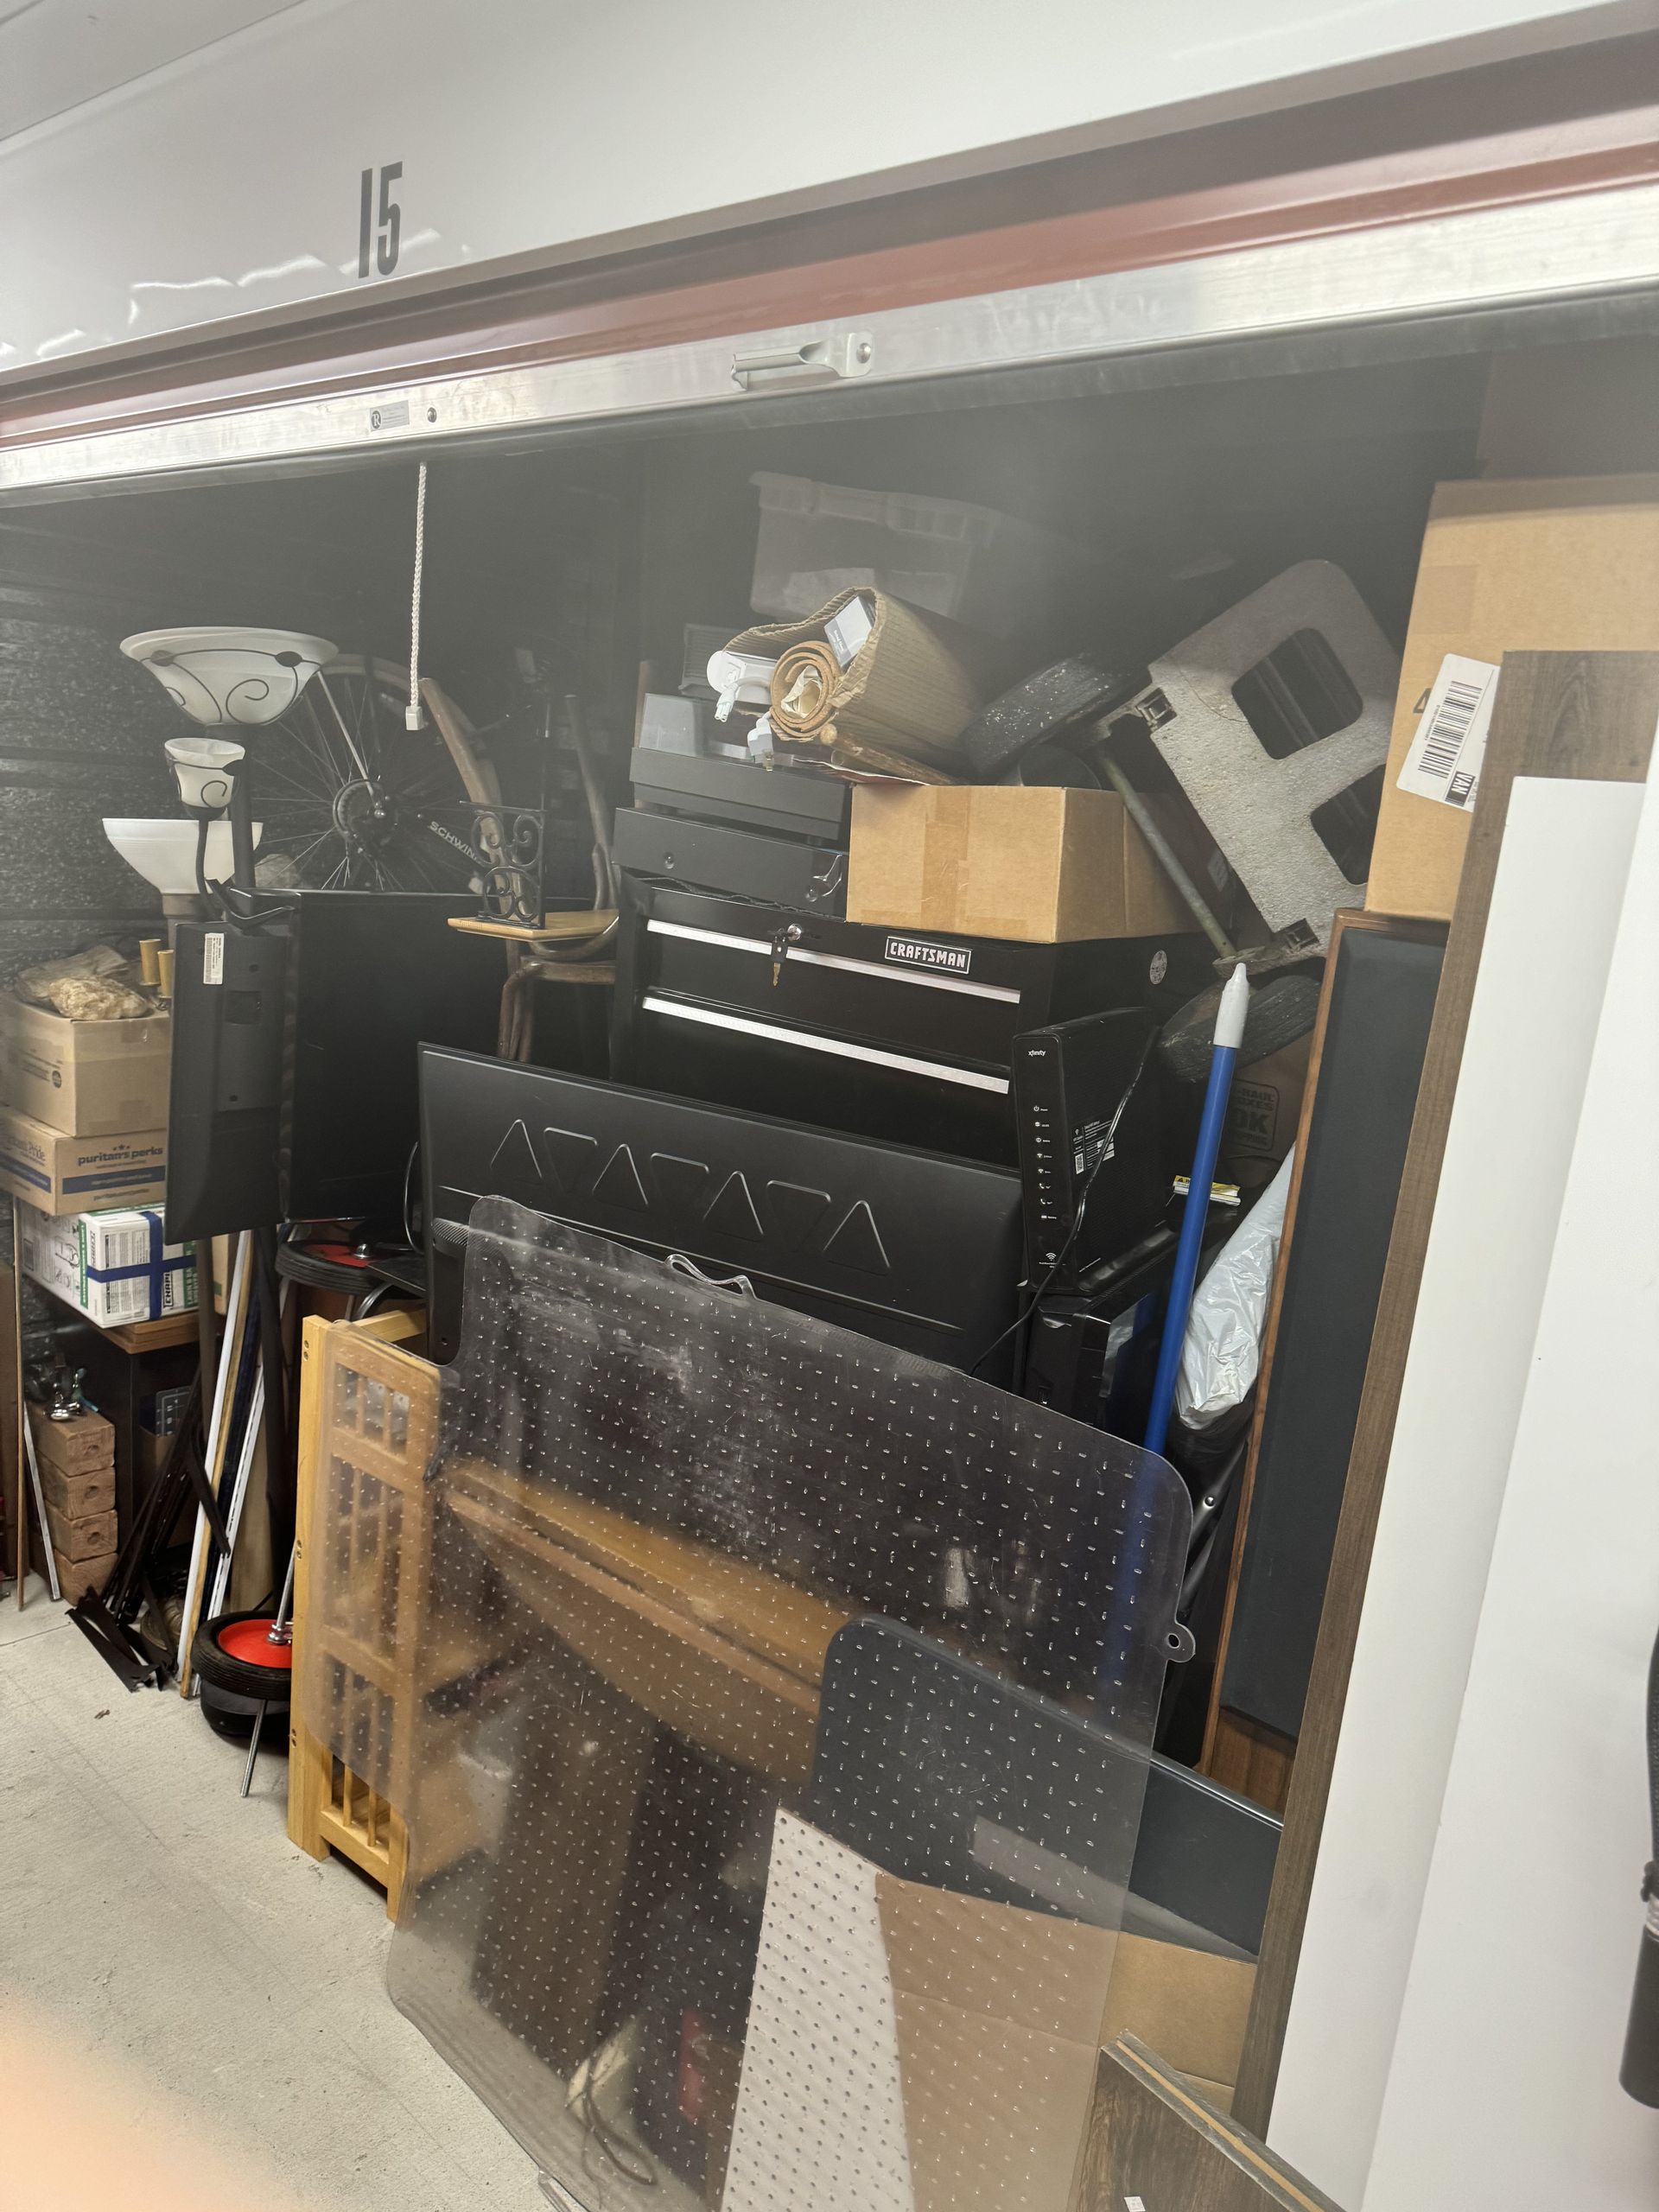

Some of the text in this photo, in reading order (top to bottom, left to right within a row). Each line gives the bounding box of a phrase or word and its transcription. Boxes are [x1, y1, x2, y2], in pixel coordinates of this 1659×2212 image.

[359, 161, 403, 278] 15
[1451, 772, 1474, 796] VAN
[428, 821, 477, 861] SCHWIN
[890, 942, 966, 968] CRAFTSMAN
[1027, 1049, 1046, 1058] xfinity
[131, 1146, 163, 1160] perks
